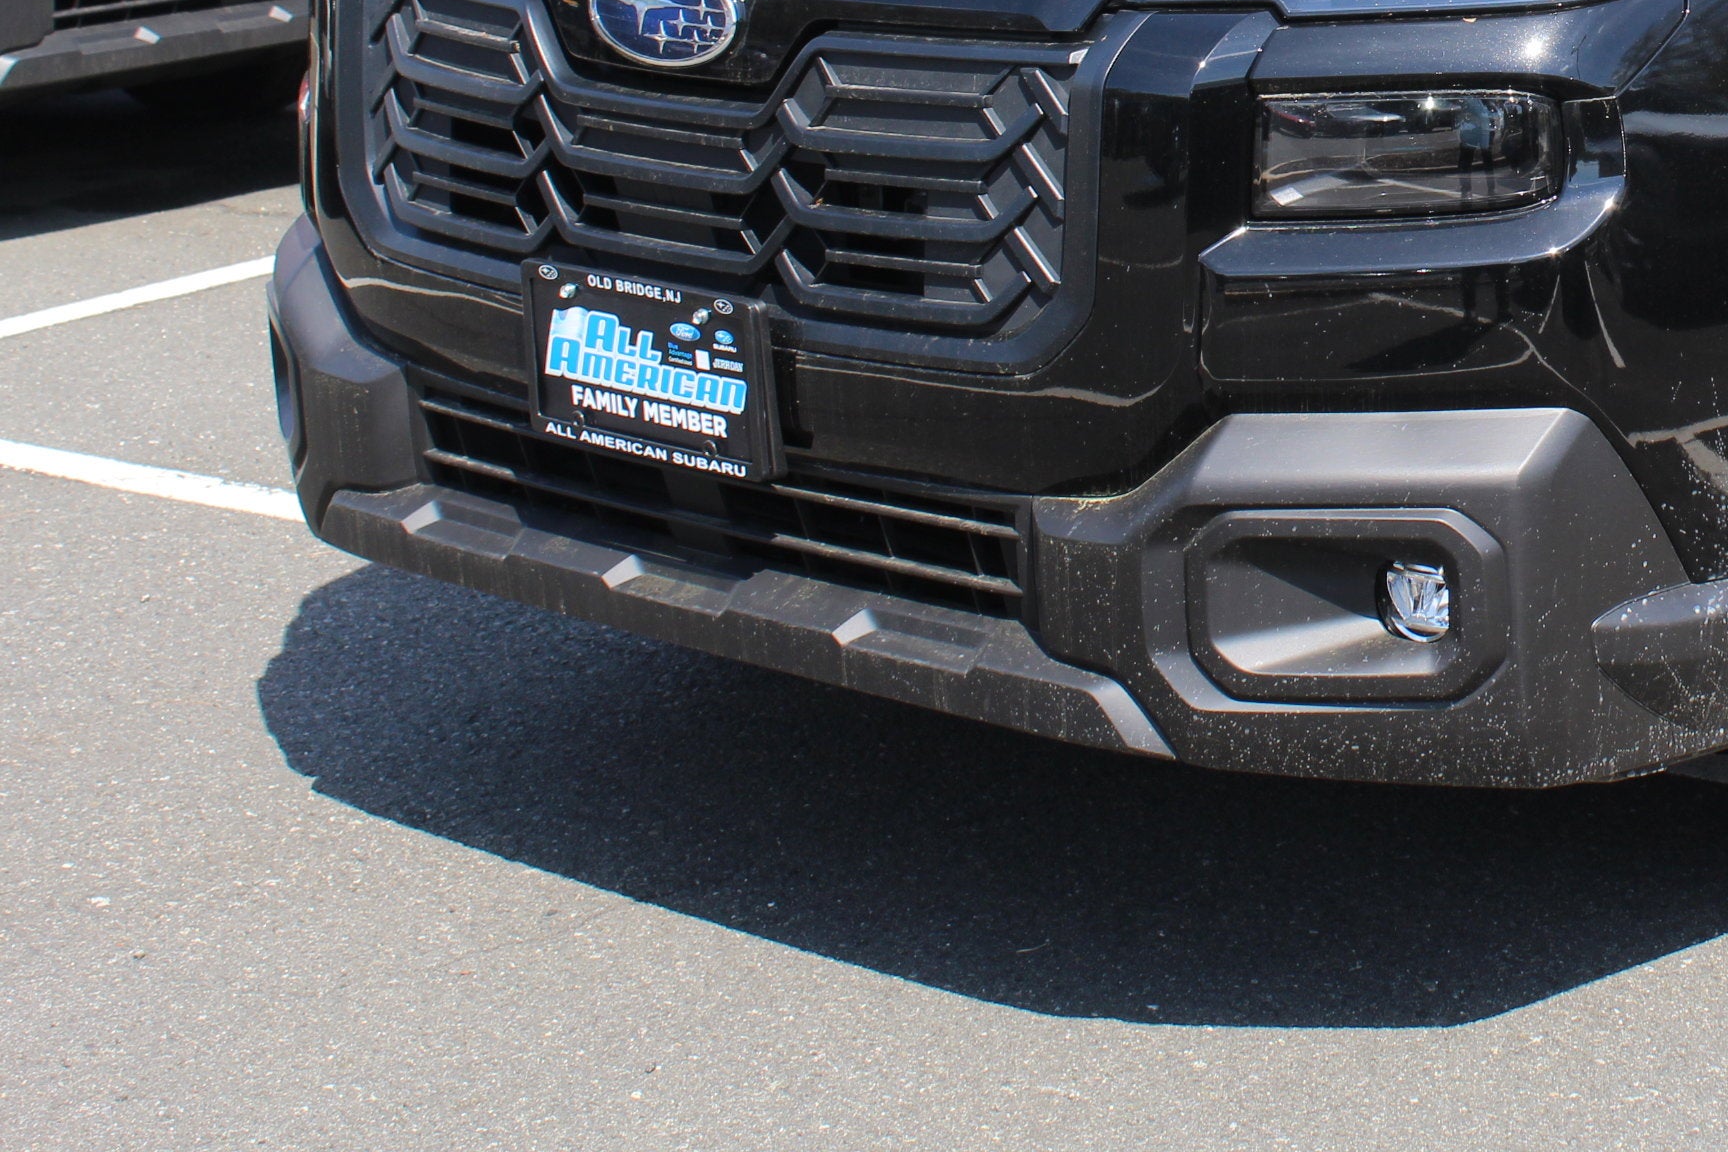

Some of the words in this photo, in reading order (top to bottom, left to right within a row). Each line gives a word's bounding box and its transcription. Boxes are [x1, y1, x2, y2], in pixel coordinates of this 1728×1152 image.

[587, 274, 611, 290] OLD
[571, 384, 639, 419] FAMILY
[643, 400, 728, 438] MEMBER
[545, 421, 577, 440] ALL
[579, 429, 667, 461] AMERICAN
[672, 448, 747, 478] SUBARU
